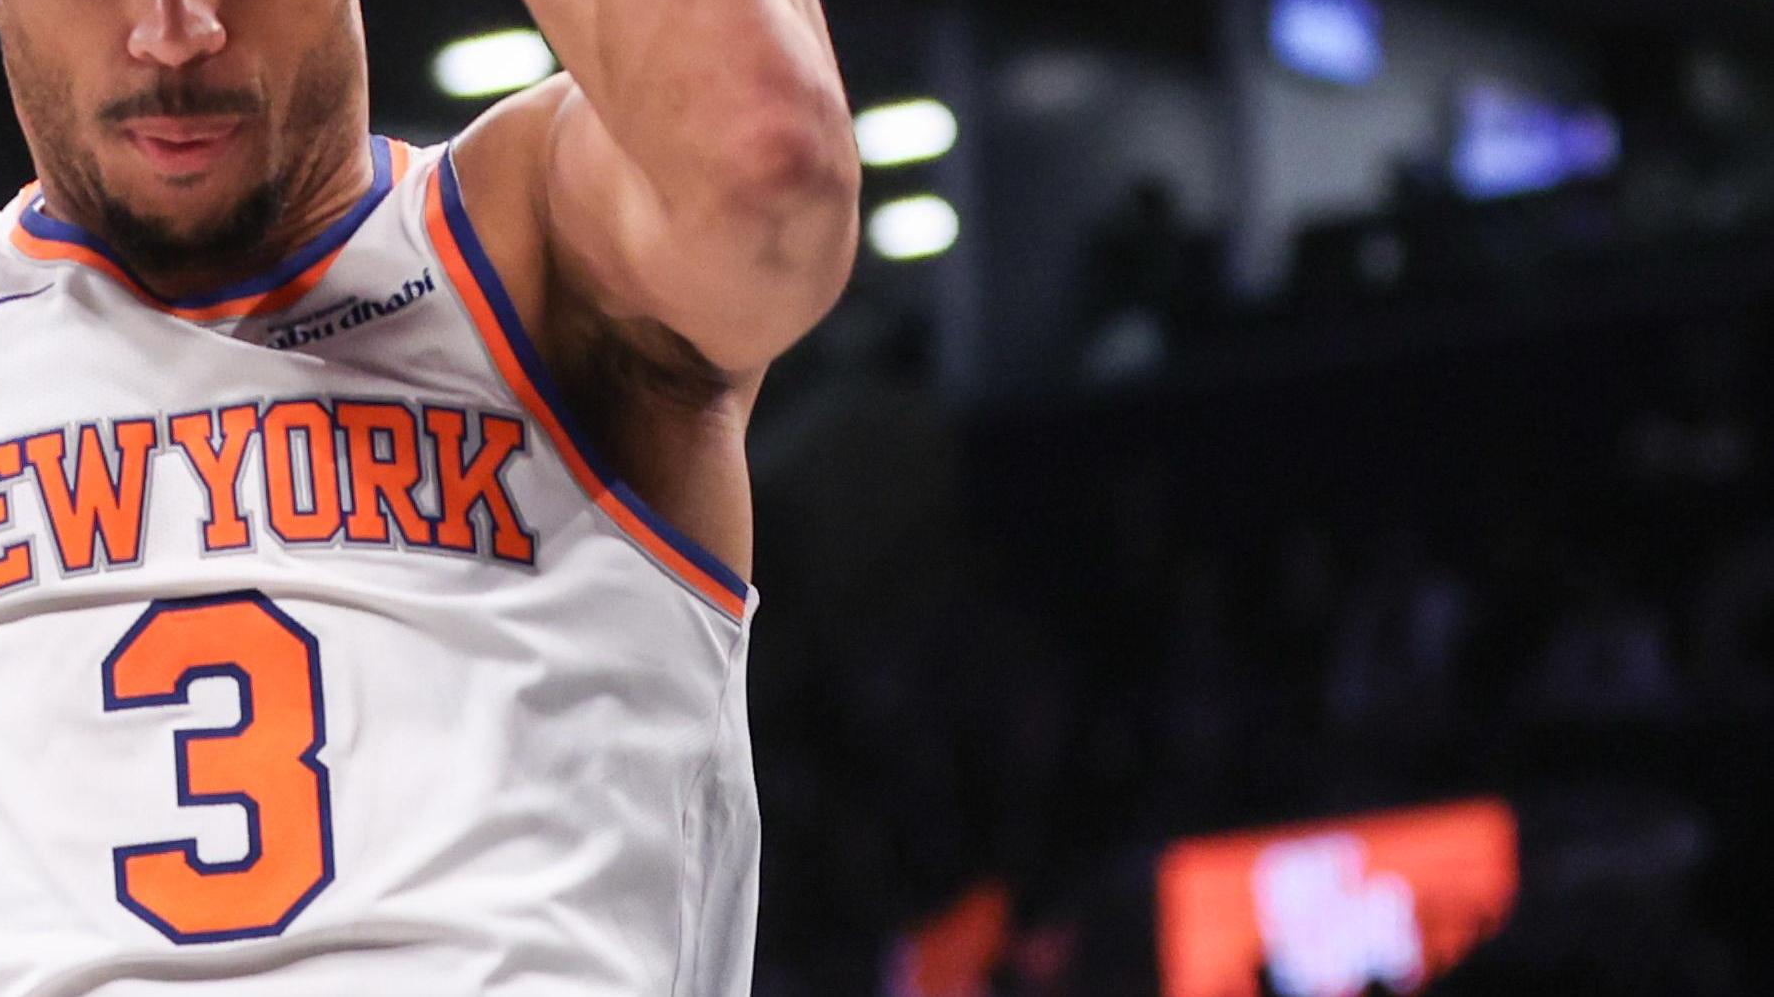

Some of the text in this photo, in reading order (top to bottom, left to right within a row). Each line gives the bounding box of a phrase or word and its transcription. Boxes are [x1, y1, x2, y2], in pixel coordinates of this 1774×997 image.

[266, 323, 335, 350] abu
[339, 267, 435, 330] dhabi
[168, 397, 540, 569] YORK
[101, 588, 336, 945] 3
